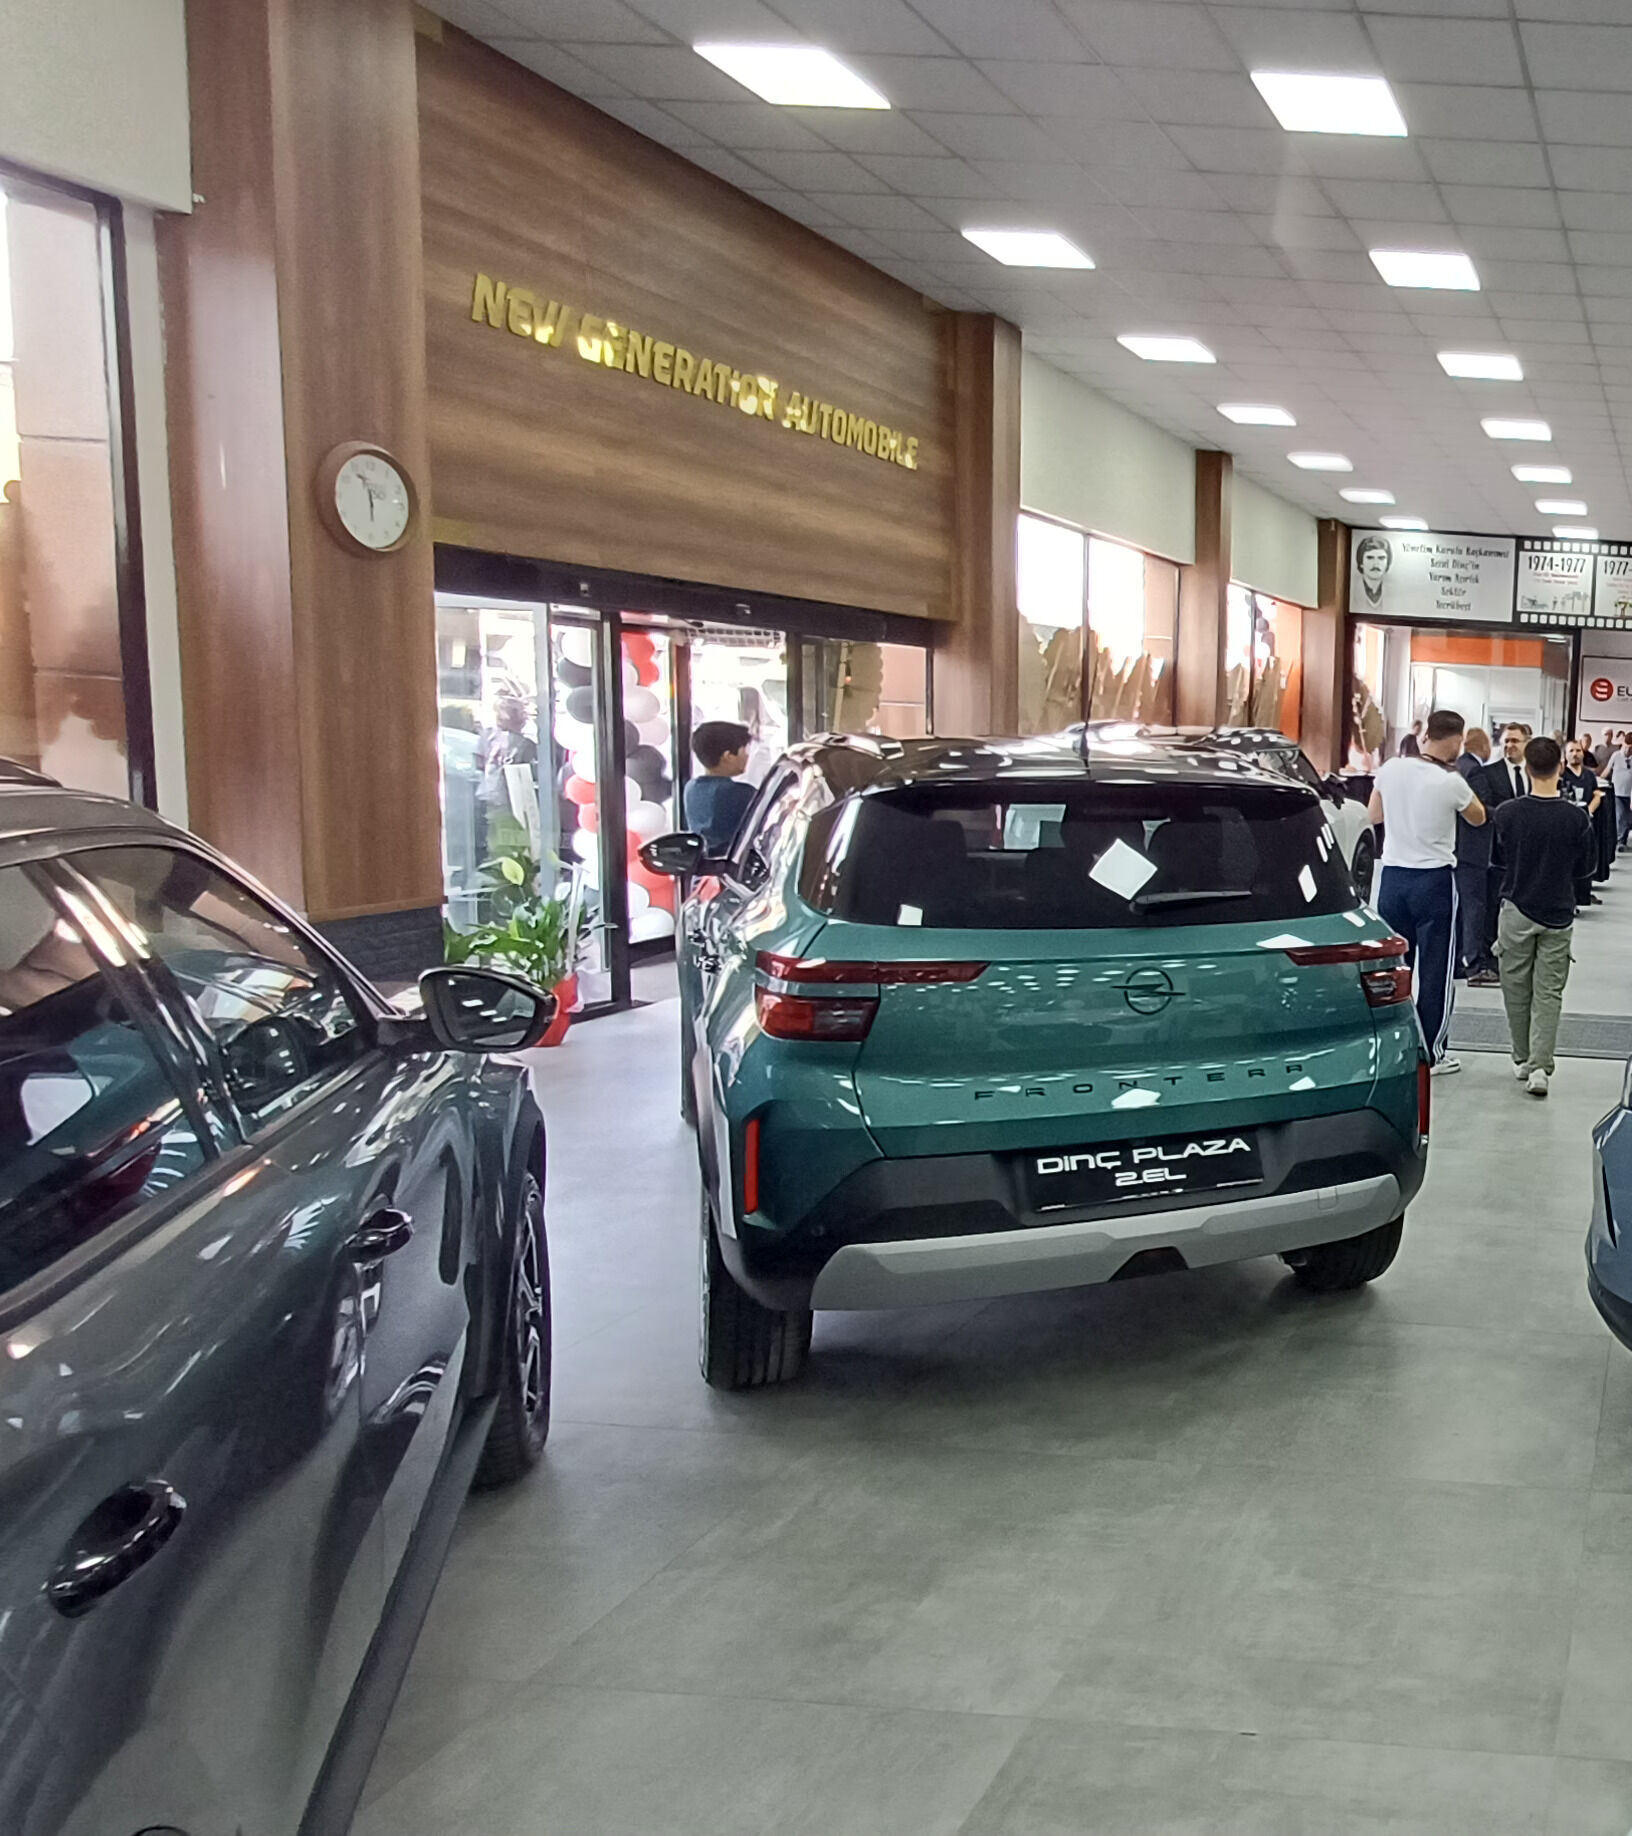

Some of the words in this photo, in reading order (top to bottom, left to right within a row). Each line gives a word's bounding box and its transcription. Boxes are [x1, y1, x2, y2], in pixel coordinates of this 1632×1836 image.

[576, 313, 779, 422] GENERATION
[781, 391, 920, 471] AUTOMOBILE
[1527, 555, 1586, 574] 1974-1977
[974, 1064, 1303, 1101] FRONTERA
[1132, 1137, 1251, 1164] PLAZA
